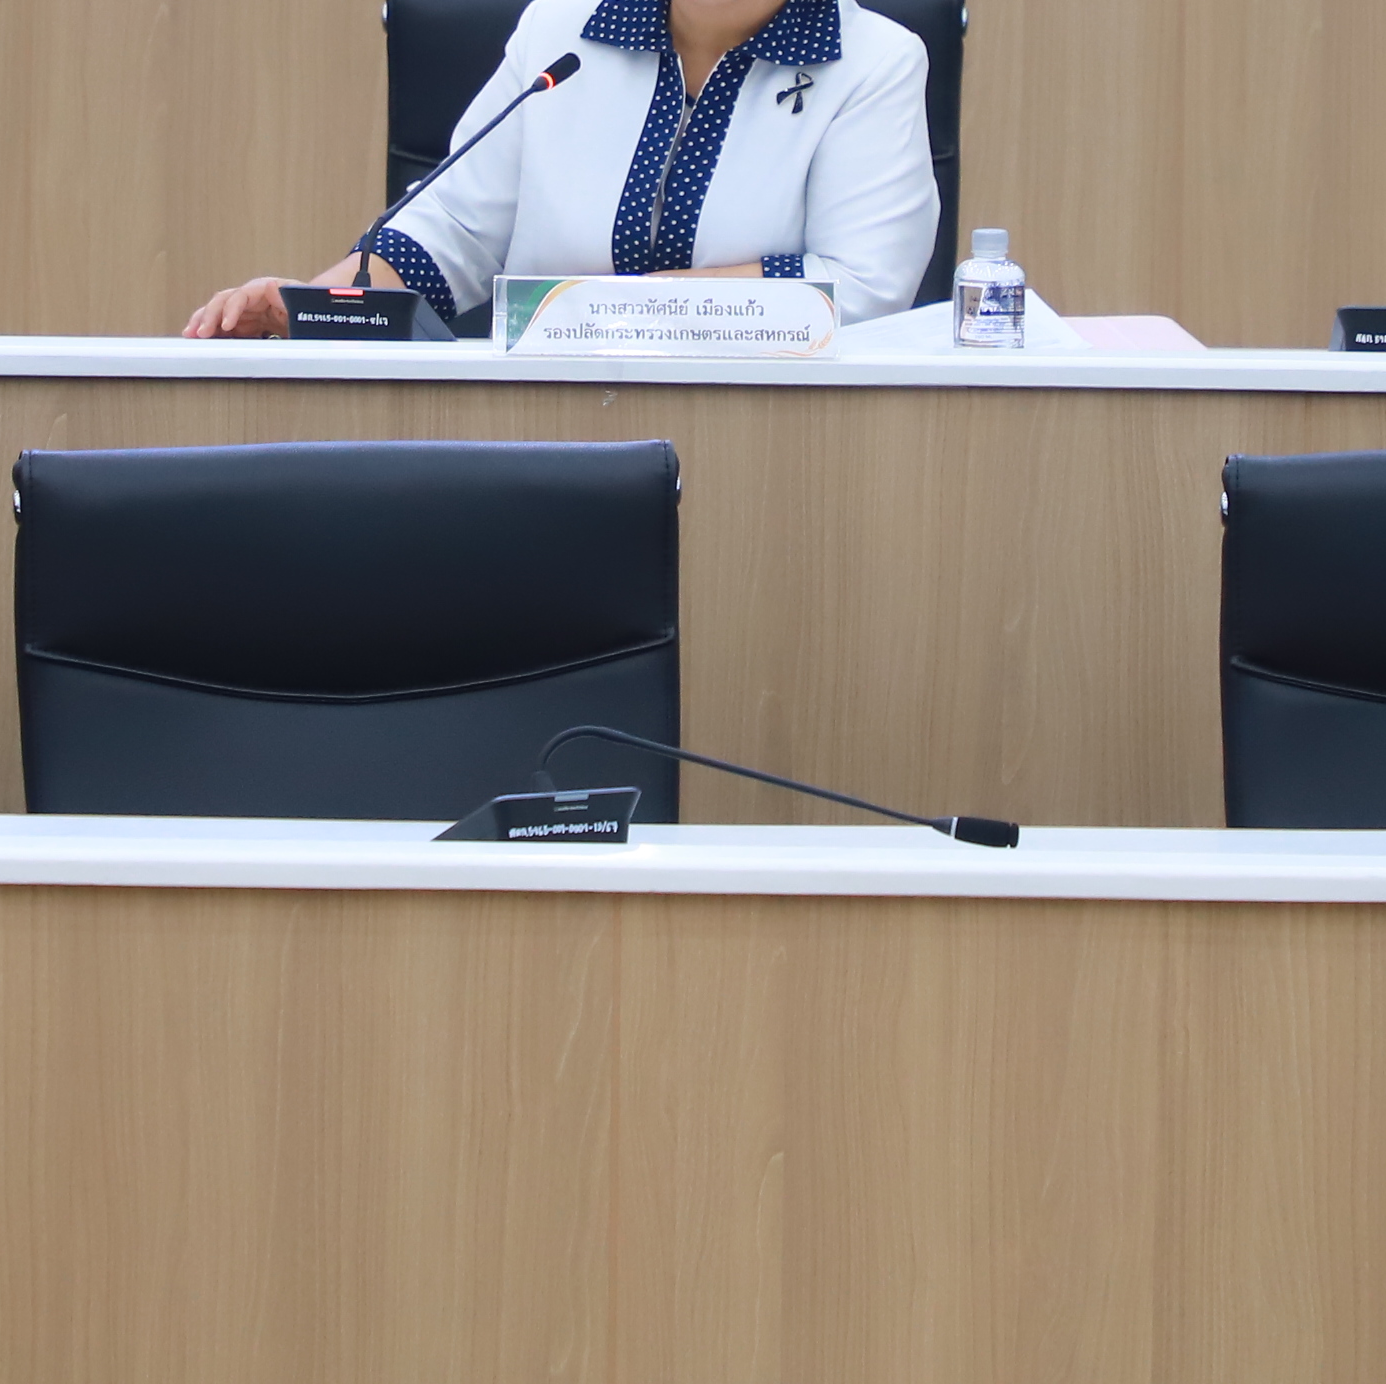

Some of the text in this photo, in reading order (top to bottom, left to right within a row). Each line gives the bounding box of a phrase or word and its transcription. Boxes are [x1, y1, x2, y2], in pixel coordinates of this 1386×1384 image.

[589, 298, 764, 317] นางสาวทัศนีย์ เมืองแก้ว
[543, 322, 811, 342] รองปลัดกระทรวงเกษตรและสหกรณ์
